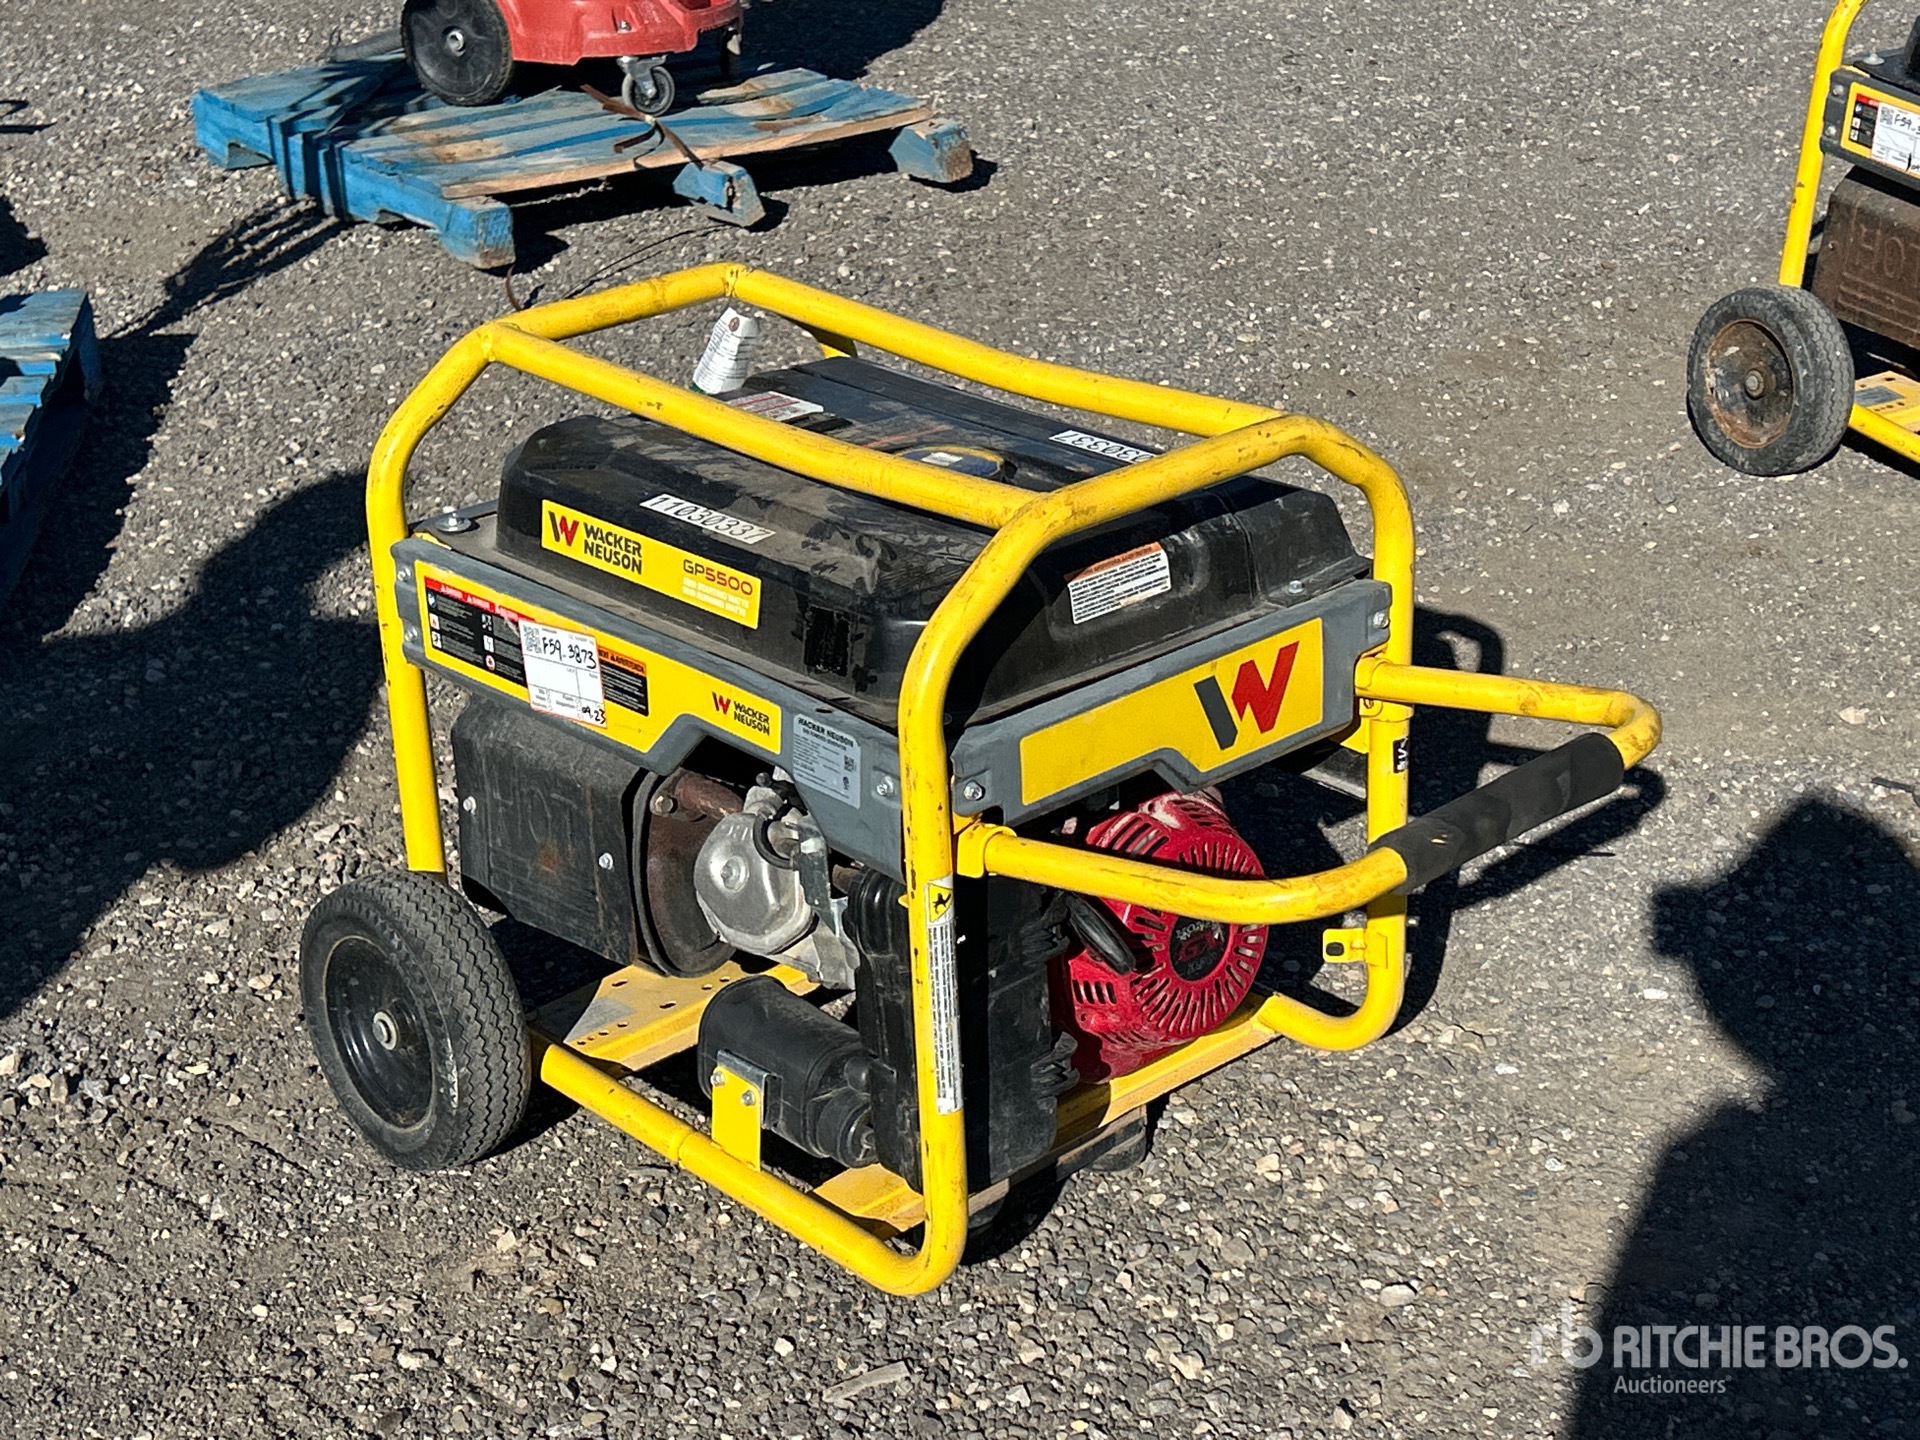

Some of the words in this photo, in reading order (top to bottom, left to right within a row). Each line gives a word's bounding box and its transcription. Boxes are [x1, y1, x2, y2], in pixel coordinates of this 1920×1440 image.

[650, 497, 771, 540] 11030337
[583, 521, 642, 559] WACKER
[584, 538, 642, 576] NEUSON
[683, 558, 753, 596] GP5500
[733, 700, 770, 726] WACKER
[733, 710, 770, 737] NEUSON
